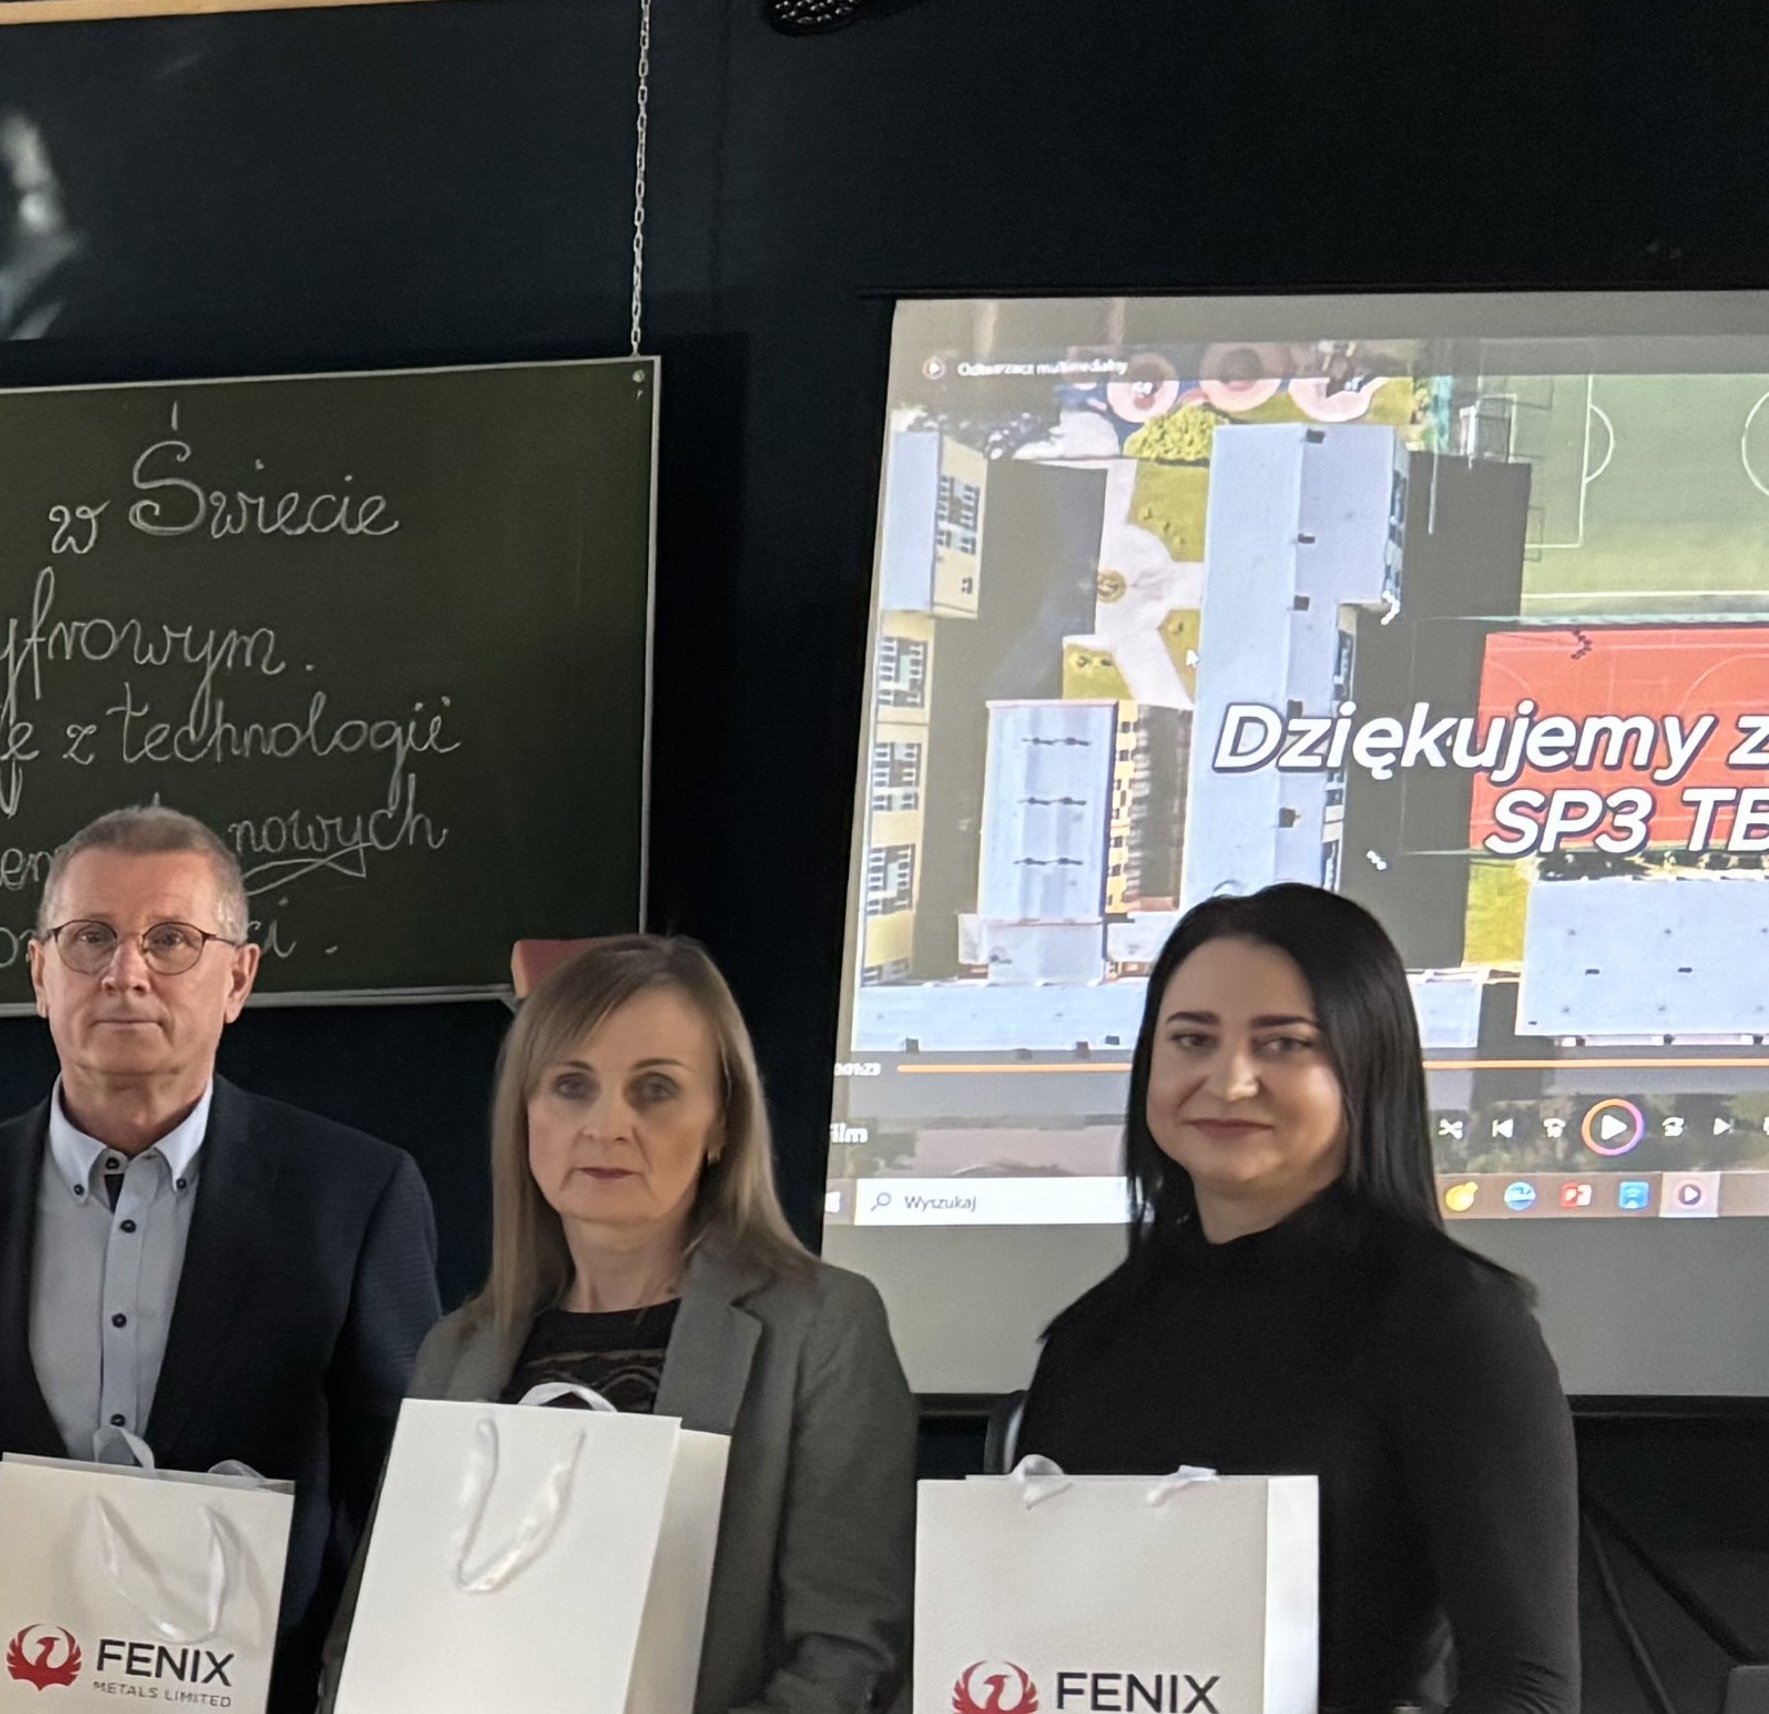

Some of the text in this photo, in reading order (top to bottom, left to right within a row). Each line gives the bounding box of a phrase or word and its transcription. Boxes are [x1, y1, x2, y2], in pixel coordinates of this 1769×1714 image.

[48, 499, 112, 554] w
[129, 402, 399, 538] Świecie
[63, 722, 96, 765] z
[106, 682, 460, 812] technologii
[1215, 699, 1717, 784] Dziękujemy
[228, 773, 449, 890] nowych
[1484, 787, 1655, 858] SP3
[904, 1195, 978, 1212] Wyszukaj
[93, 1680, 232, 1708] METALS LIMITED
[96, 1638, 235, 1688] FENIX
